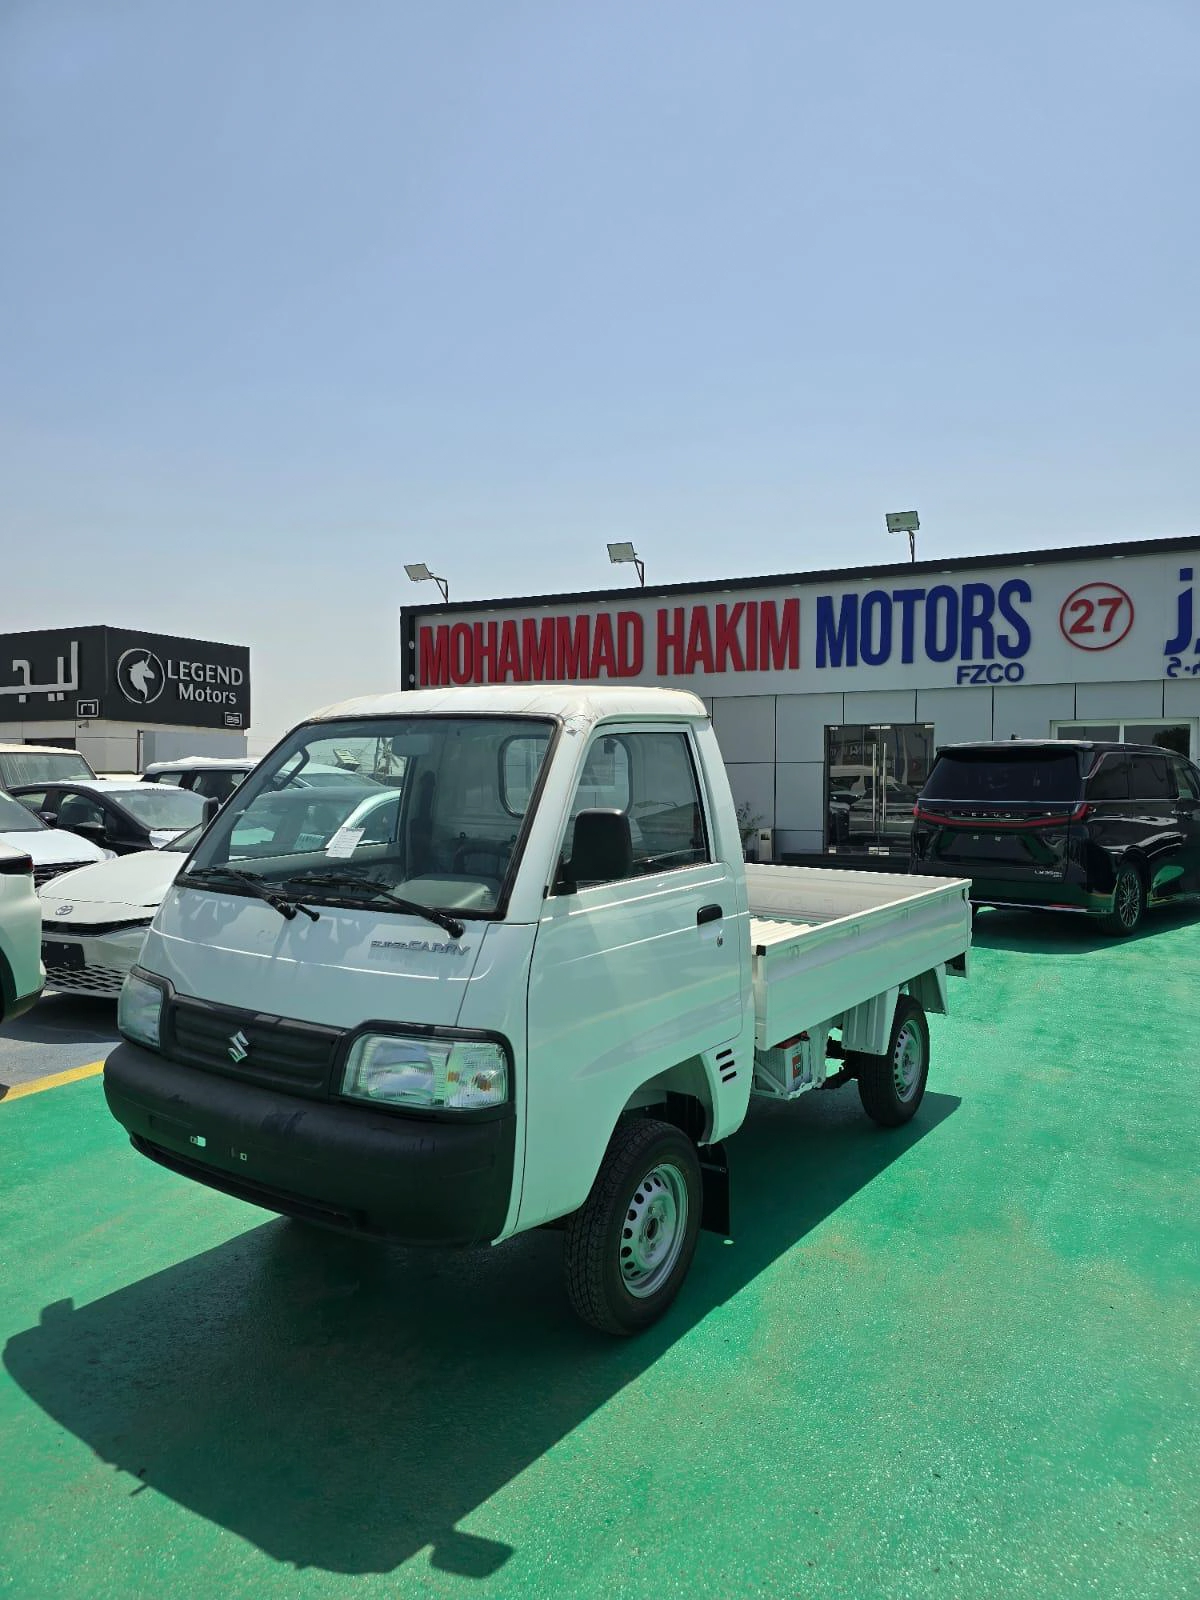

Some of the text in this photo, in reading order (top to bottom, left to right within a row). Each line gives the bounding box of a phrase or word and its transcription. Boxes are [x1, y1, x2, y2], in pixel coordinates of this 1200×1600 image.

[1069, 597, 1123, 634] 27
[419, 578, 1032, 686] MOHAMMAD HAKIM MOTORS
[167, 658, 243, 686] LEGEND
[956, 662, 1025, 685] FZCO
[178, 683, 236, 705] Motors
